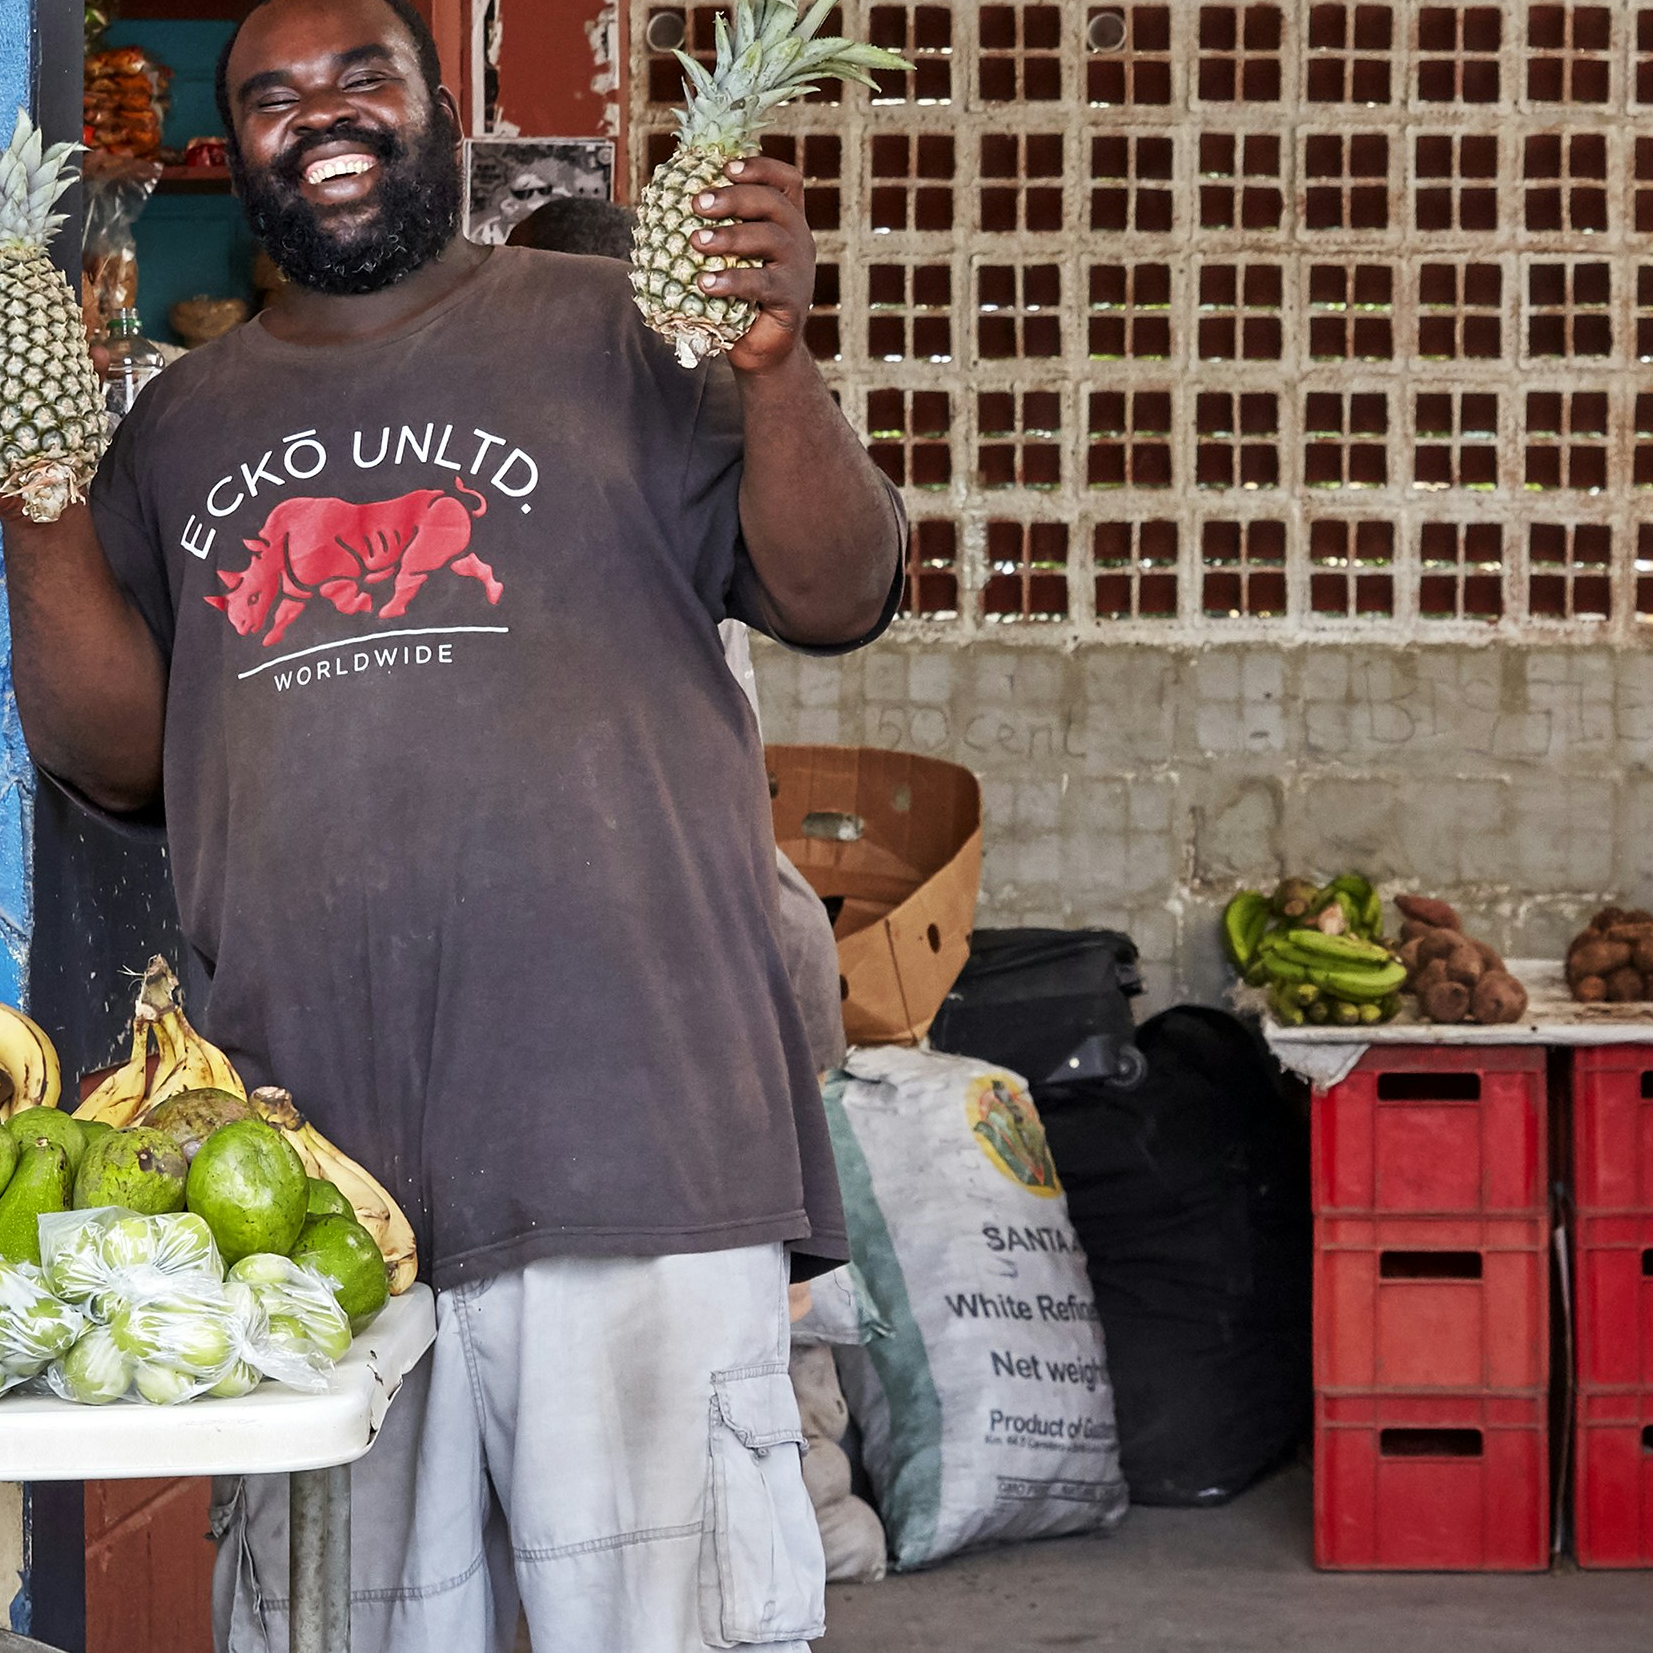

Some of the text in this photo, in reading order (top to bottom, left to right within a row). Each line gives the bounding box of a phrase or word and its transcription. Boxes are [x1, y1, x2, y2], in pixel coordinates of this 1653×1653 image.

[274, 644, 453, 692] WORLDWIDE
[982, 1224, 1069, 1252] SANTA
[945, 1292, 1033, 1320] White
[990, 1350, 1042, 1381] Net
[989, 1409, 1064, 1438] Product
